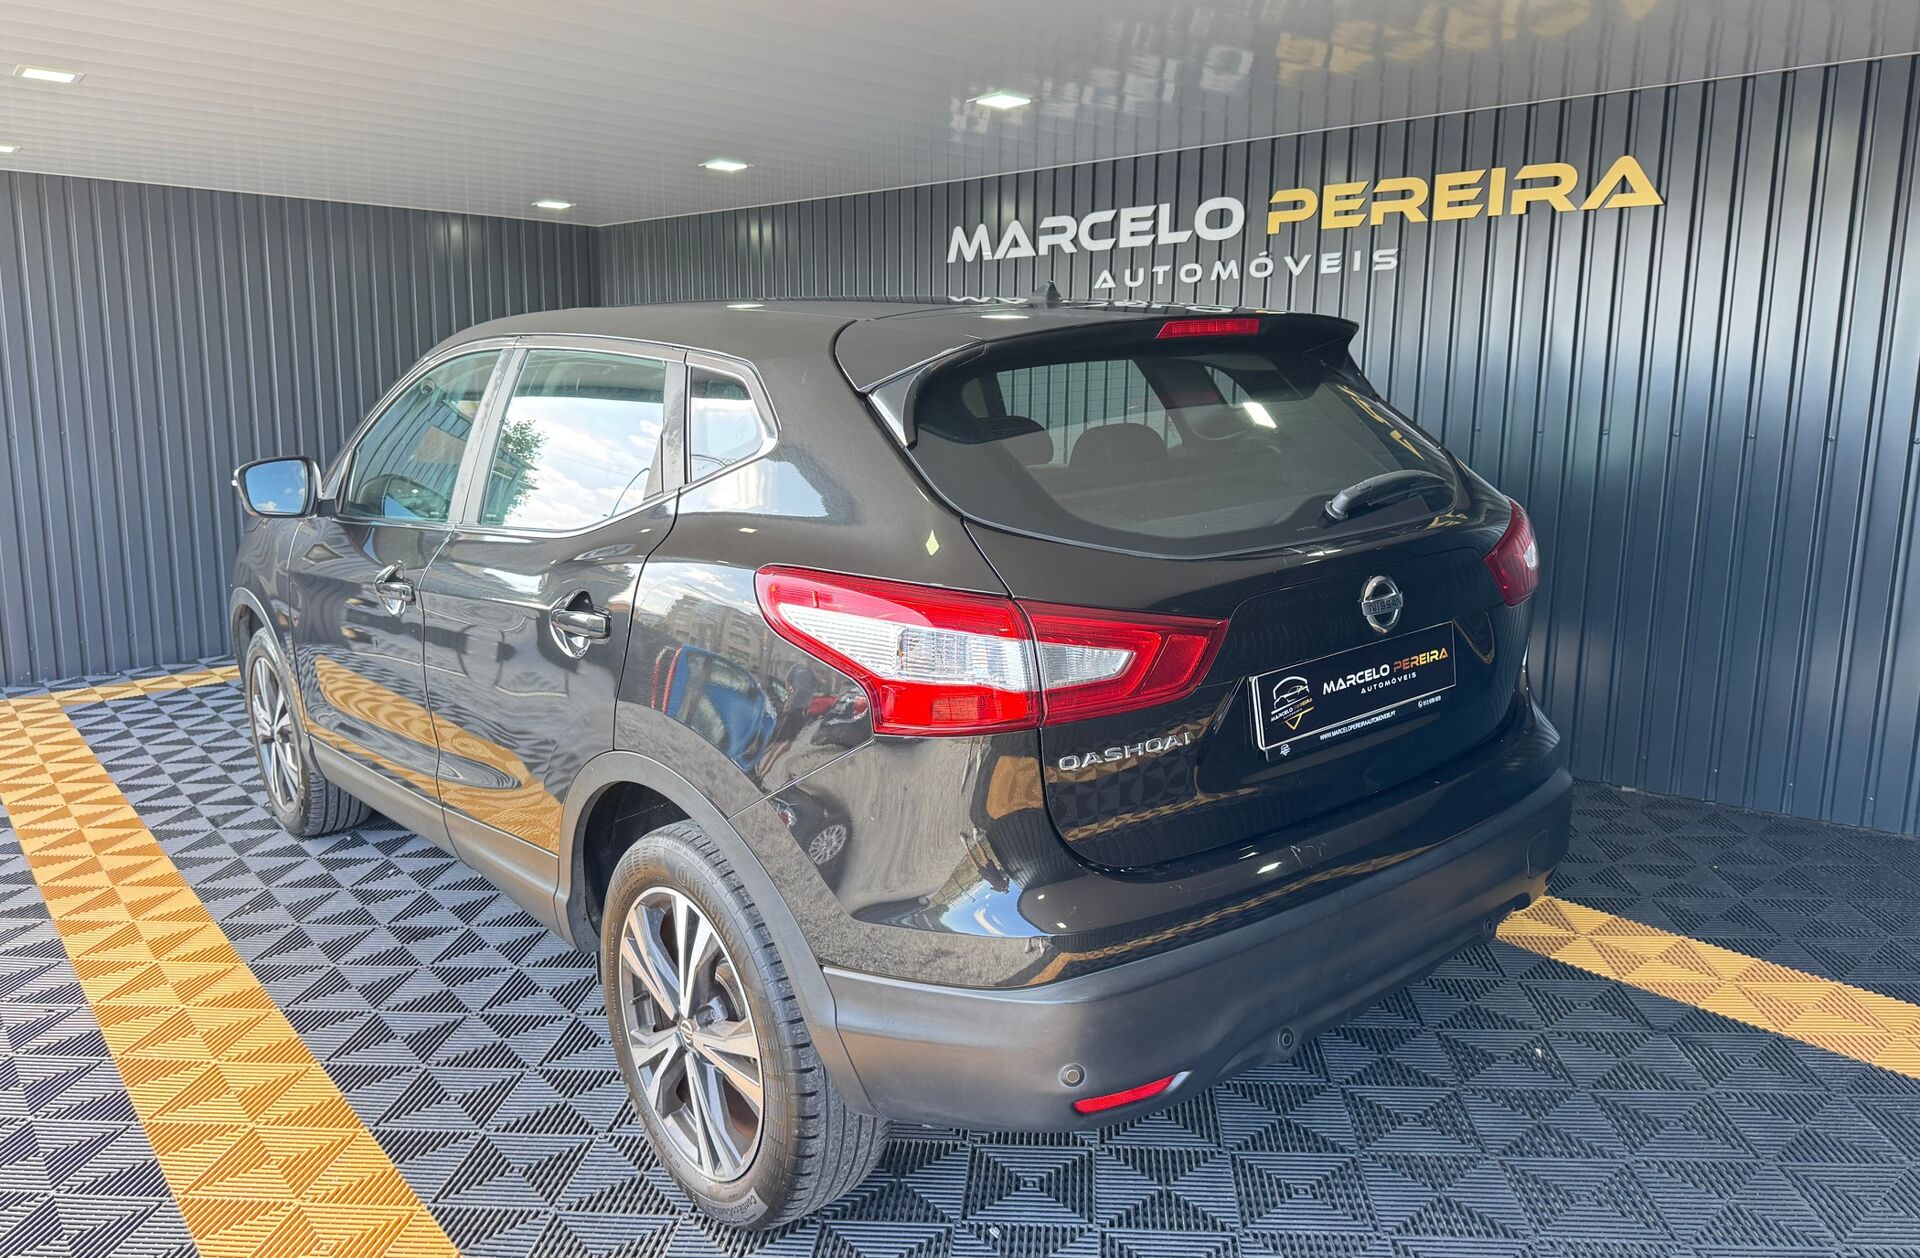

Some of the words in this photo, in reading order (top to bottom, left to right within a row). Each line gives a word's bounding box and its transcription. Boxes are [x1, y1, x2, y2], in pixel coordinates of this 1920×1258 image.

[947, 196, 1245, 264] MARCELO
[1266, 155, 1664, 236] PEREIRA
[1094, 247, 1400, 290] AUTOMÓVEIS
[1367, 596, 1400, 614] NISSAN
[1322, 663, 1391, 696] MARCELO
[1393, 647, 1449, 673] PEREIRA
[1360, 671, 1418, 695] AUTOMÓVEIS
[1058, 731, 1192, 771] QASHQAI
